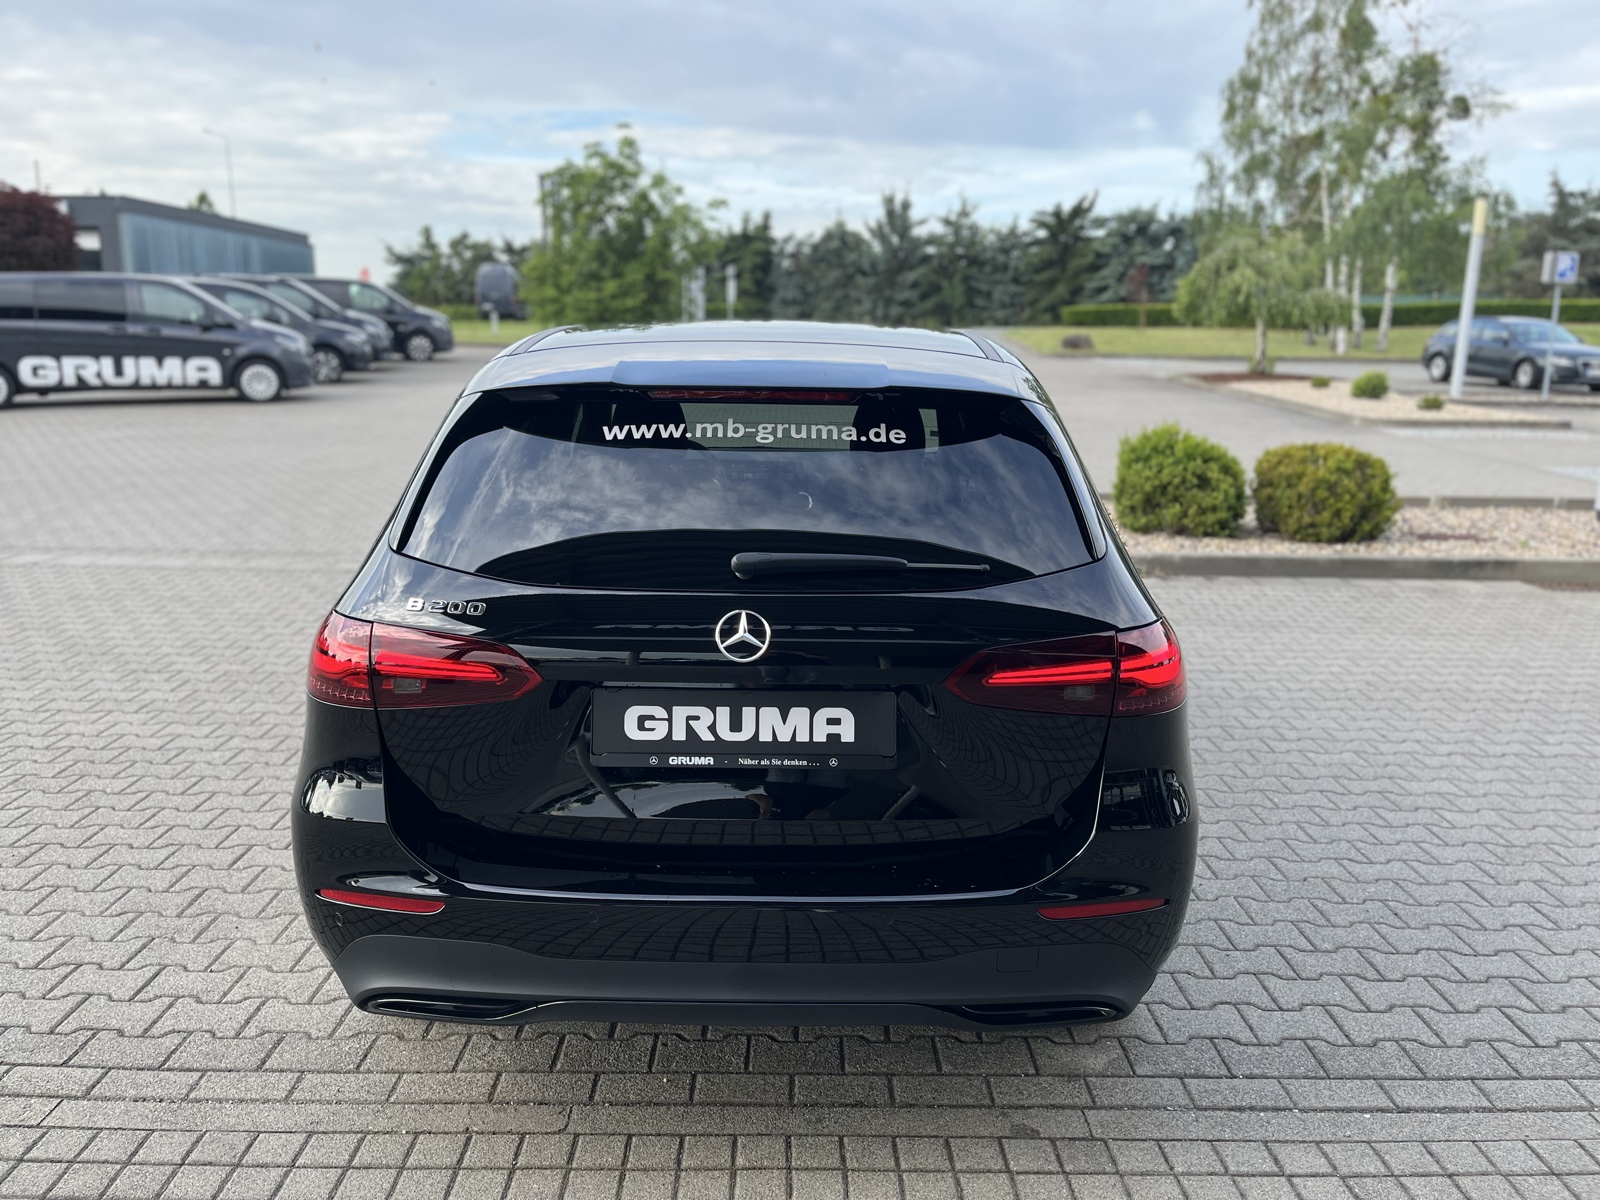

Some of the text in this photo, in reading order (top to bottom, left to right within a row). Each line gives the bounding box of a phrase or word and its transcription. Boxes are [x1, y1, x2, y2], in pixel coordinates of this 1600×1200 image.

[17, 355, 224, 388] GRUMA
[602, 418, 907, 444] www.mb-gruma.de
[406, 597, 487, 616] B 200
[623, 705, 855, 743] GRUMA
[668, 756, 714, 765] GRUMA
[738, 757, 759, 766] Näher
[760, 758, 770, 766] als
[771, 758, 782, 766] Sie
[783, 758, 808, 766] denken
